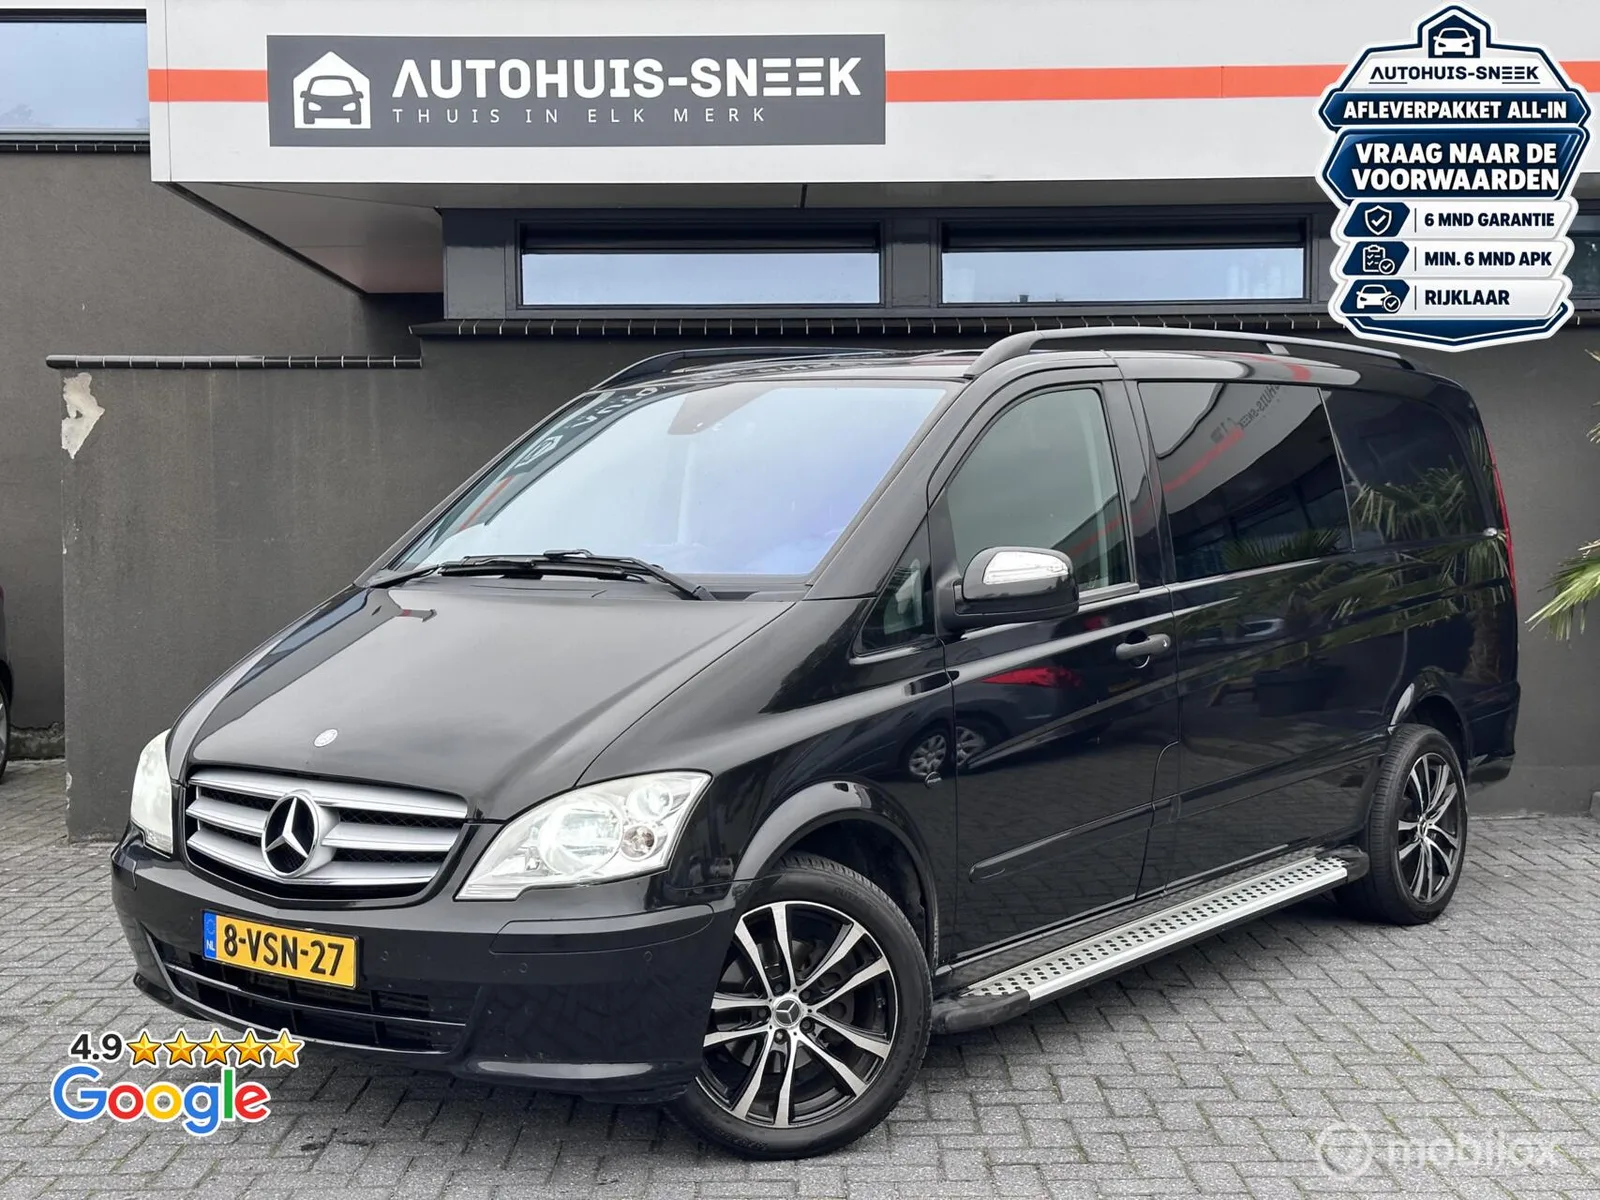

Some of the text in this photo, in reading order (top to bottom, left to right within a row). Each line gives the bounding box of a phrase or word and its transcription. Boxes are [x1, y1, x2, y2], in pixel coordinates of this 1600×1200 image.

[392, 57, 862, 99] AUTOHUIS-SNEEK
[393, 107, 767, 124] THUIS IN ELK MERK
[206, 940, 215, 951] NL
[224, 923, 345, 977] 8-VSN-27
